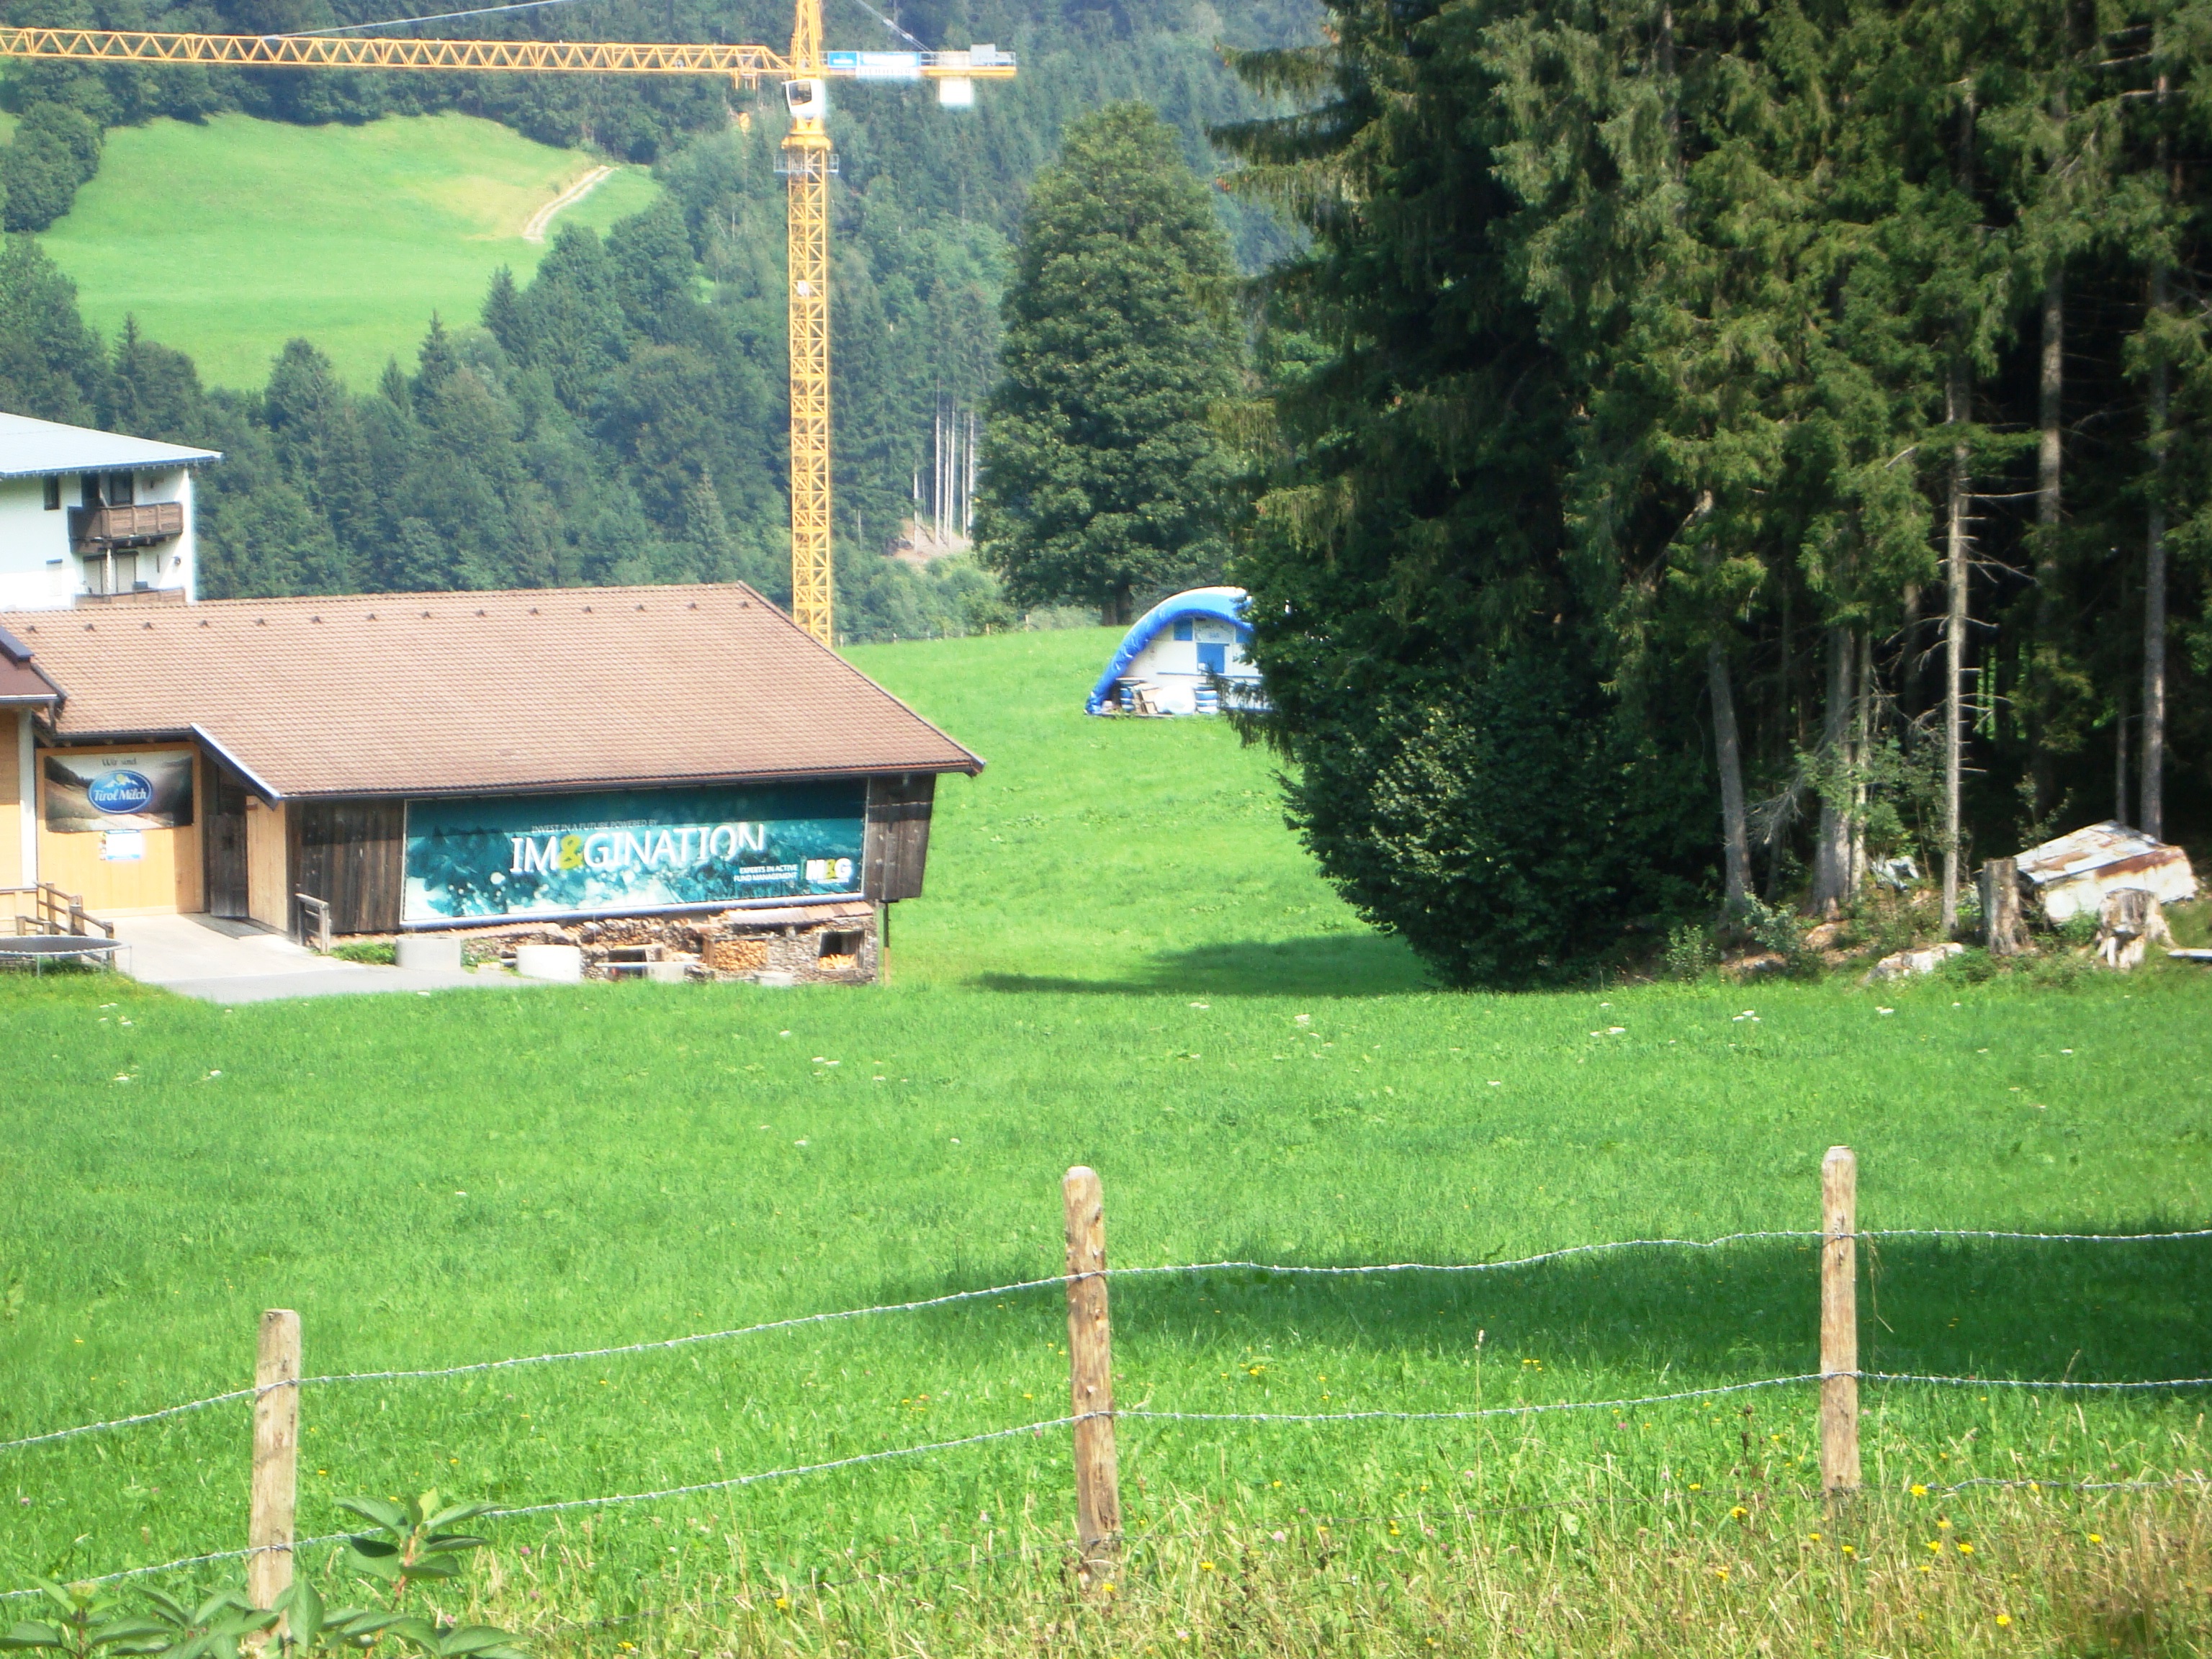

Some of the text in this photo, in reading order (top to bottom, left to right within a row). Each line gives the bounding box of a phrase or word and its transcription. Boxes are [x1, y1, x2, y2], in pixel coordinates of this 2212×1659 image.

[94, 788, 147, 801] Tirol Milch
[531, 824, 559, 833] INVEST
[561, 823, 571, 832] IN
[579, 822, 609, 831] FUTURE
[611, 819, 647, 829] POWERED
[509, 822, 765, 873] IM&GINATION
[739, 866, 765, 874] EXPERTS
[752, 872, 799, 881] MANAGEMENT
